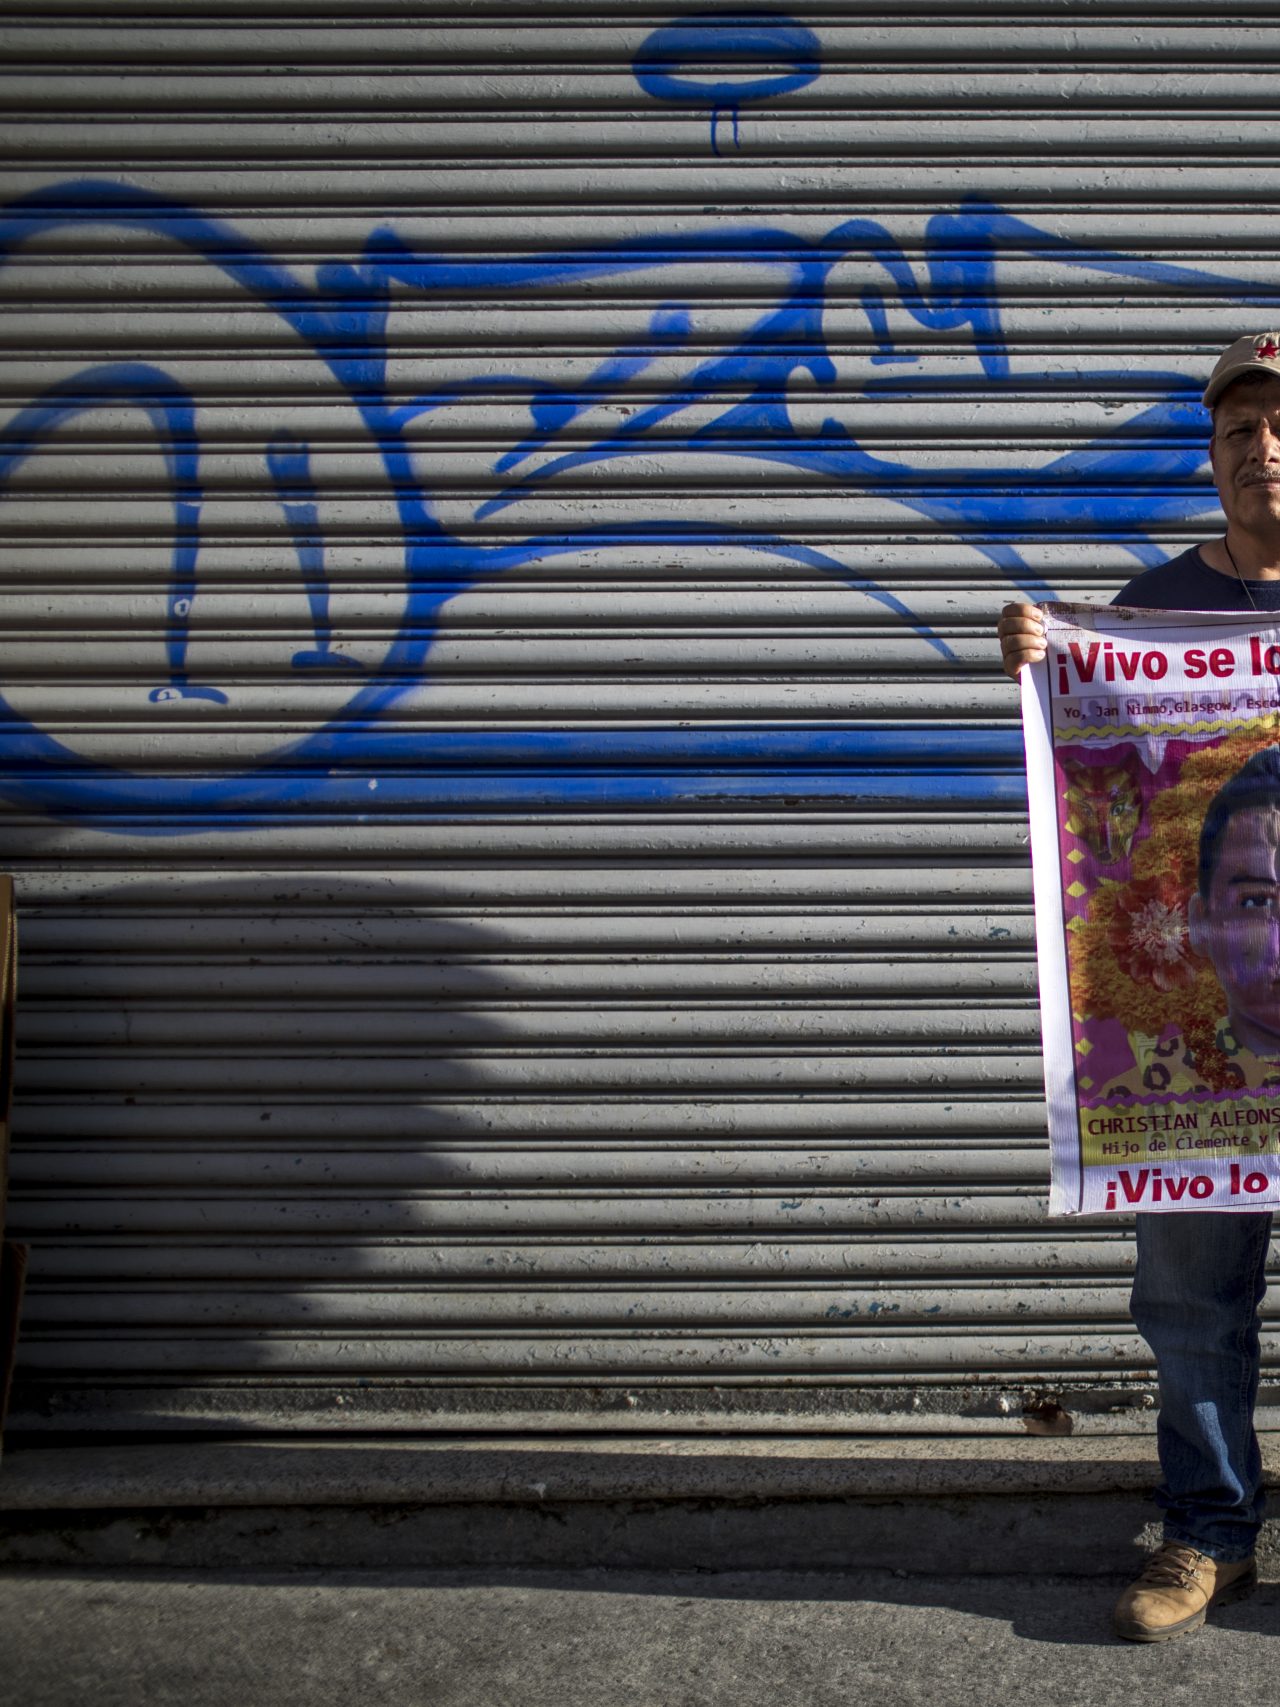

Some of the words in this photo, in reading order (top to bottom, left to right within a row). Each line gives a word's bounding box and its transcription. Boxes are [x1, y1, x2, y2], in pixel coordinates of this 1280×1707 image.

[1057, 642, 1168, 695] ¡Vivo
[1184, 648, 1235, 679] se
[1064, 706, 1087, 721] Yo,
[1096, 705, 1119, 718] Jan
[1088, 1113, 1198, 1136] CHRISTIAN
[1103, 1142, 1139, 1158] Hijo
[1148, 1139, 1167, 1152] de
[1176, 1134, 1249, 1150] Clemente
[1259, 1134, 1268, 1148] y
[1105, 1167, 1214, 1210] ¡Vivo
[1230, 1163, 1269, 1195] lo
